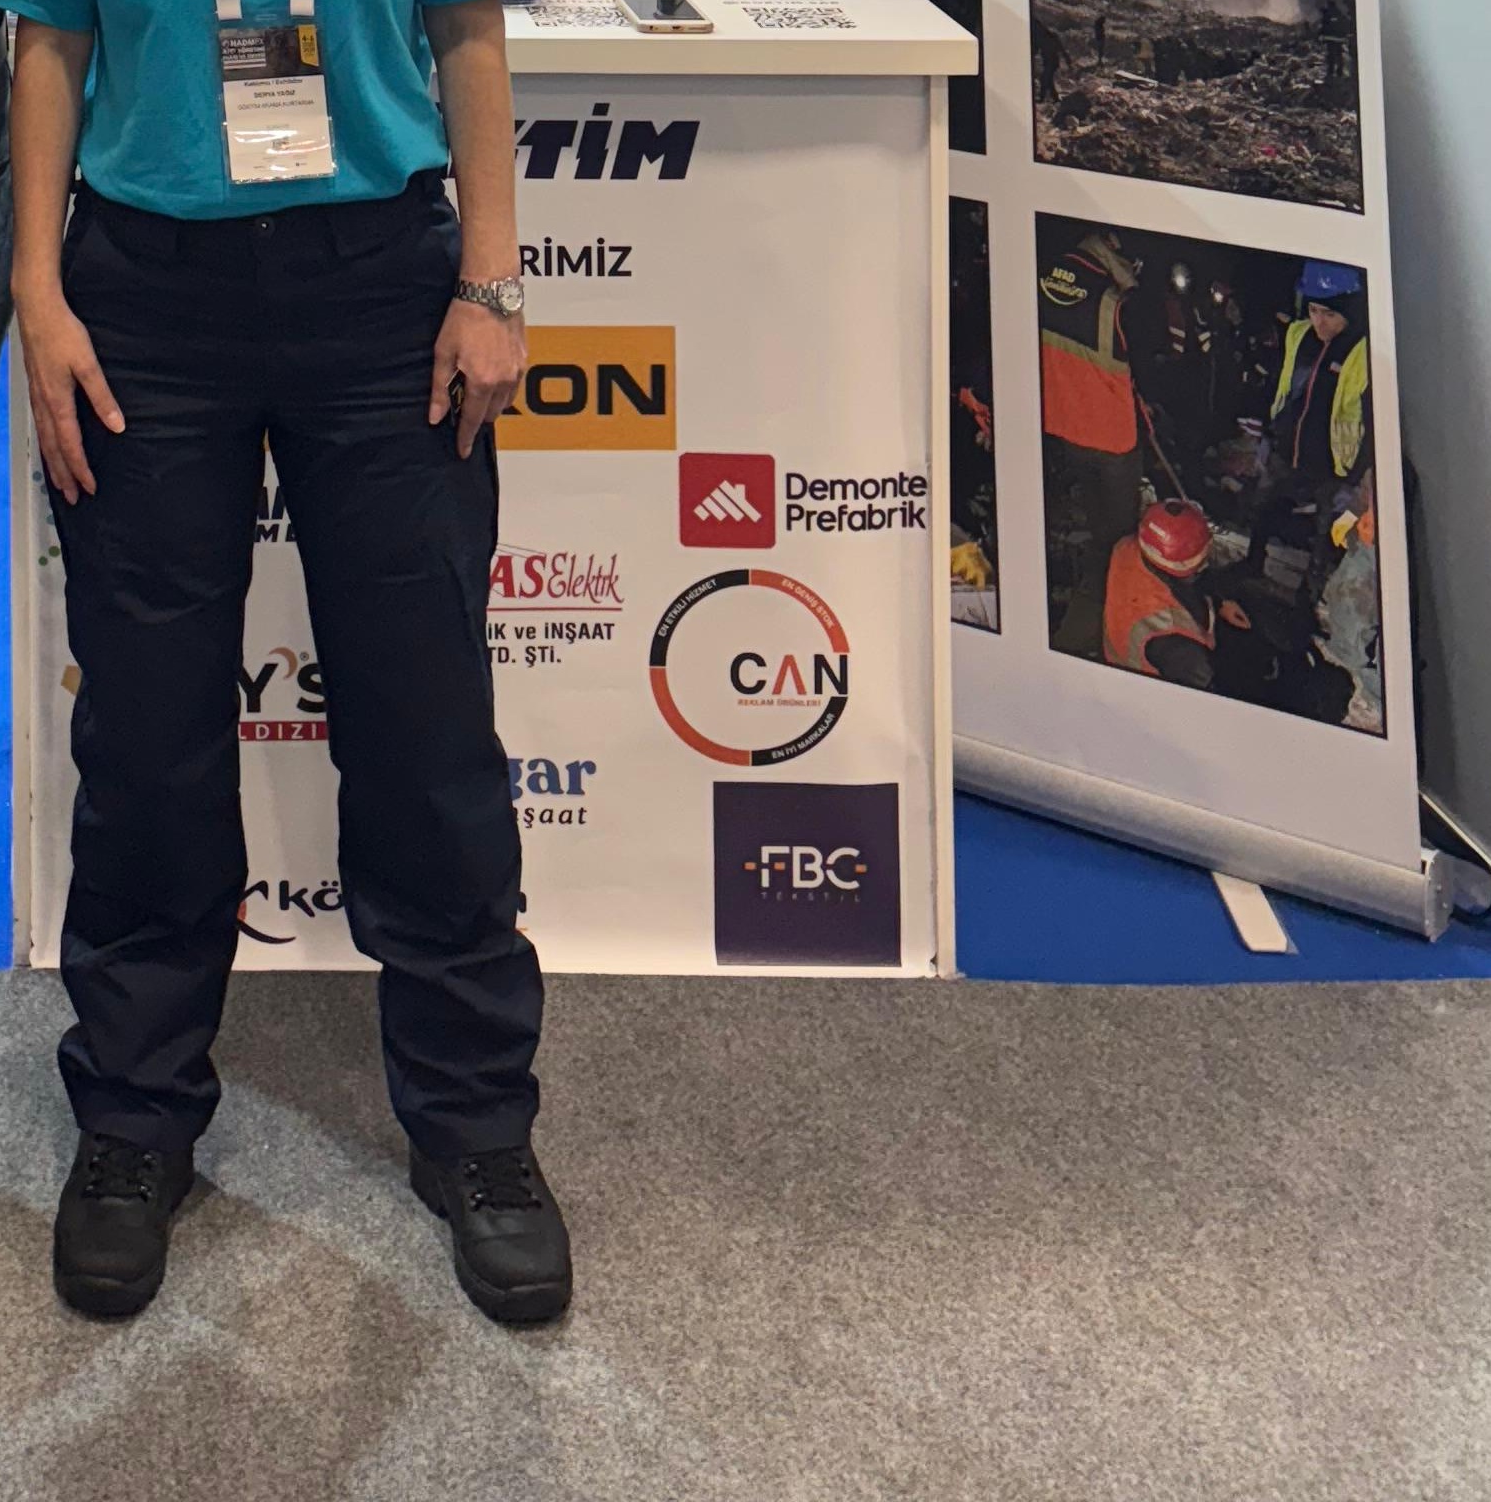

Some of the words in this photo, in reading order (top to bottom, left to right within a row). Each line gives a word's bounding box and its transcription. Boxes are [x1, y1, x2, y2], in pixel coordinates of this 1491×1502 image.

[514, 103, 701, 179] TİM
[501, 364, 666, 415] ON
[785, 470, 927, 500] Demonte
[785, 501, 927, 533] Prefabrik
[514, 626, 536, 640] ve
[512, 806, 588, 829] şaat
[761, 845, 861, 890] FBC
